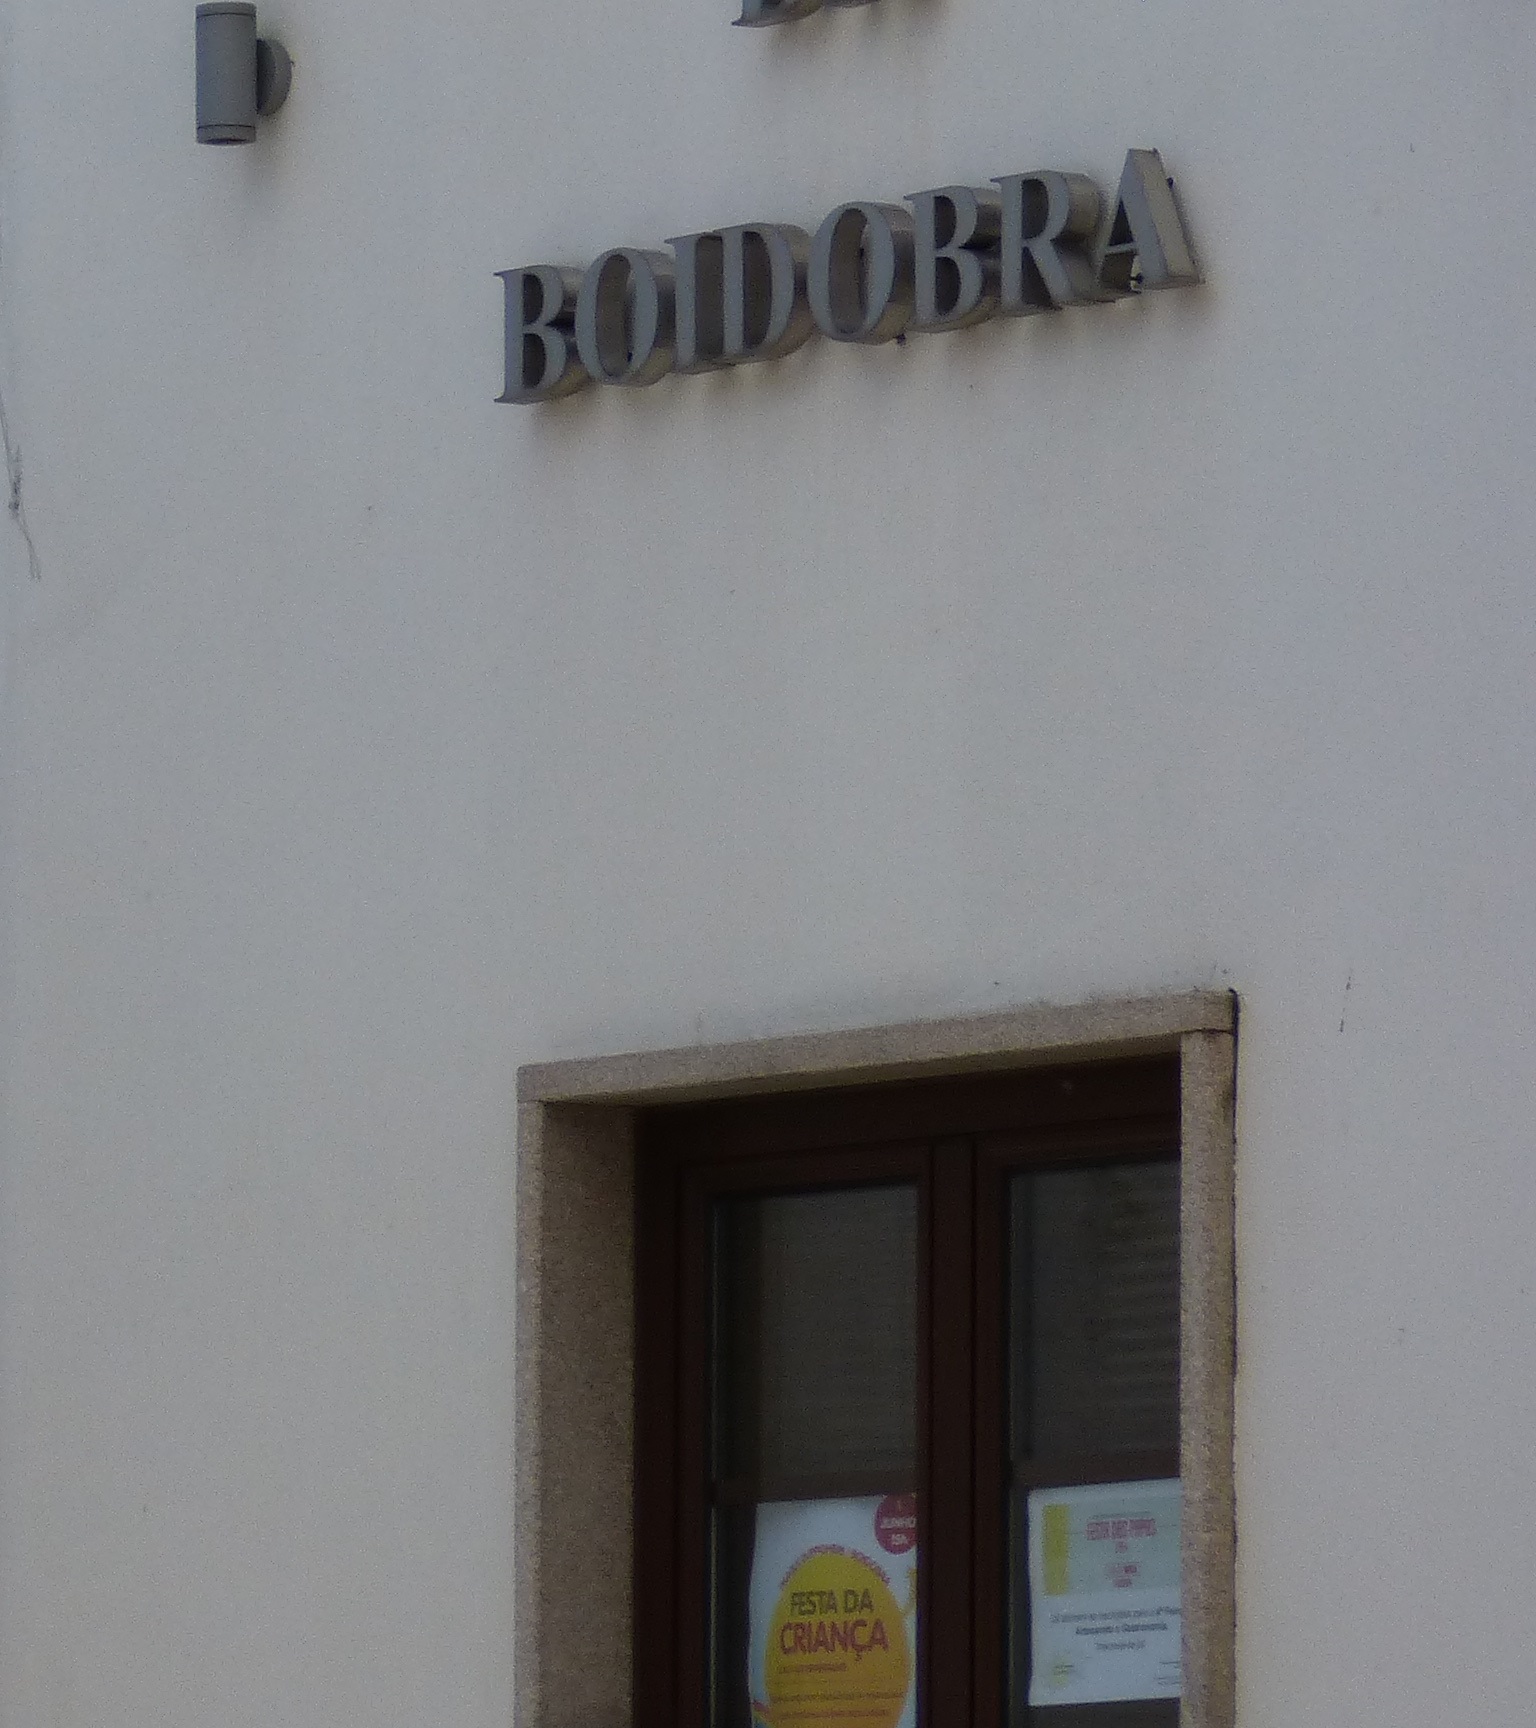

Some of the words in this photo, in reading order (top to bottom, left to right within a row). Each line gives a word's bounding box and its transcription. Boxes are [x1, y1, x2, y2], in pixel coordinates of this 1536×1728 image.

[493, 148, 1205, 404] BOIDOBRA
[789, 1590, 838, 1616] FESTA
[842, 1587, 875, 1615] DA
[779, 1618, 891, 1661] CRIANÇA
